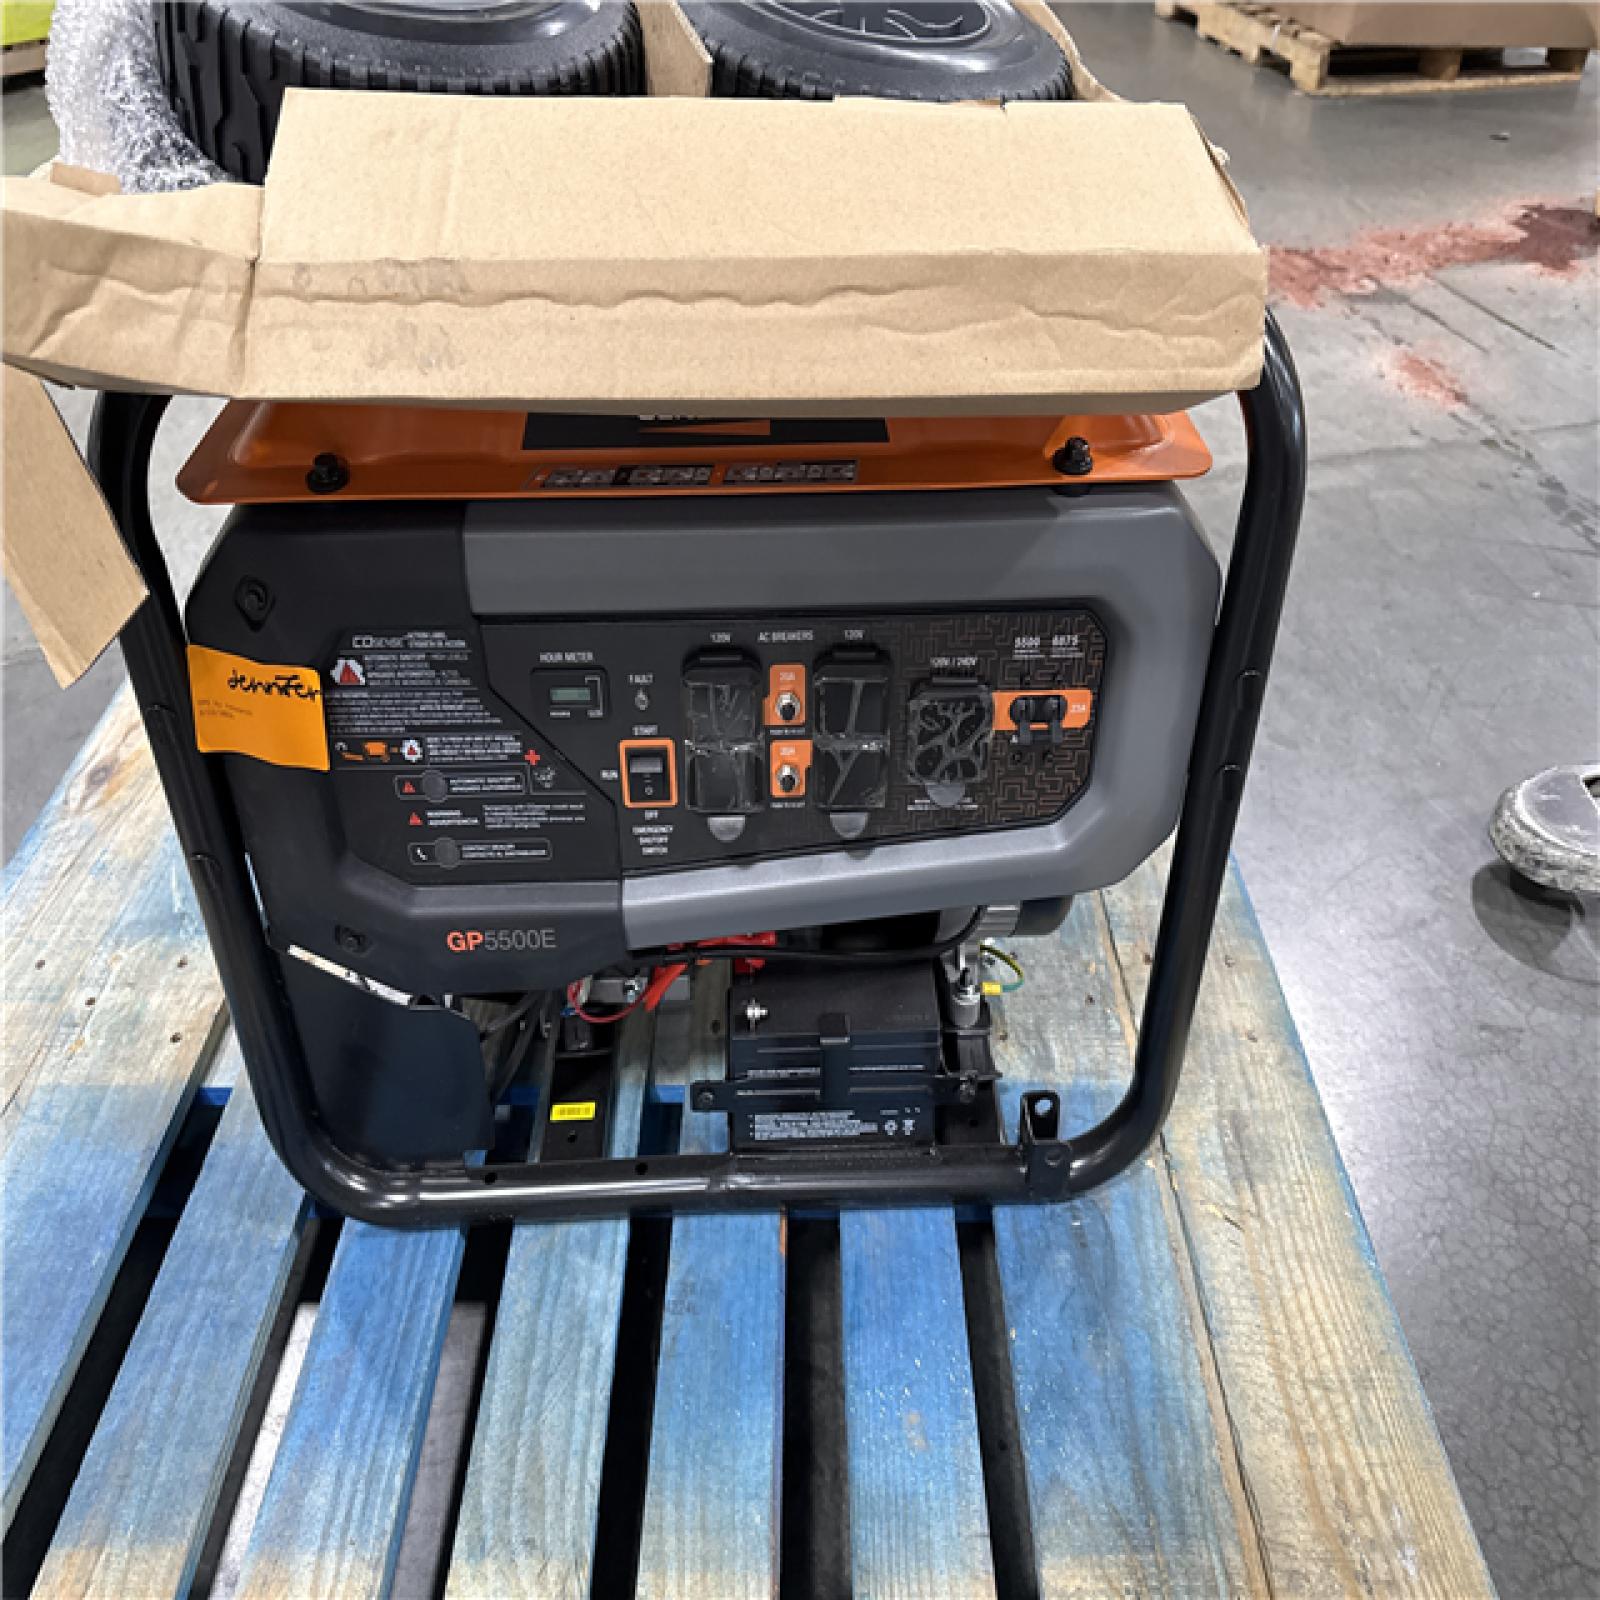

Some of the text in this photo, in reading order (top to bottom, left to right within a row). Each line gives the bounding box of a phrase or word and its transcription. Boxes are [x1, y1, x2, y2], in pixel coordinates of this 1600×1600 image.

[539, 651, 593, 663] HOUR METER
[446, 927, 558, 951] GP5500E
